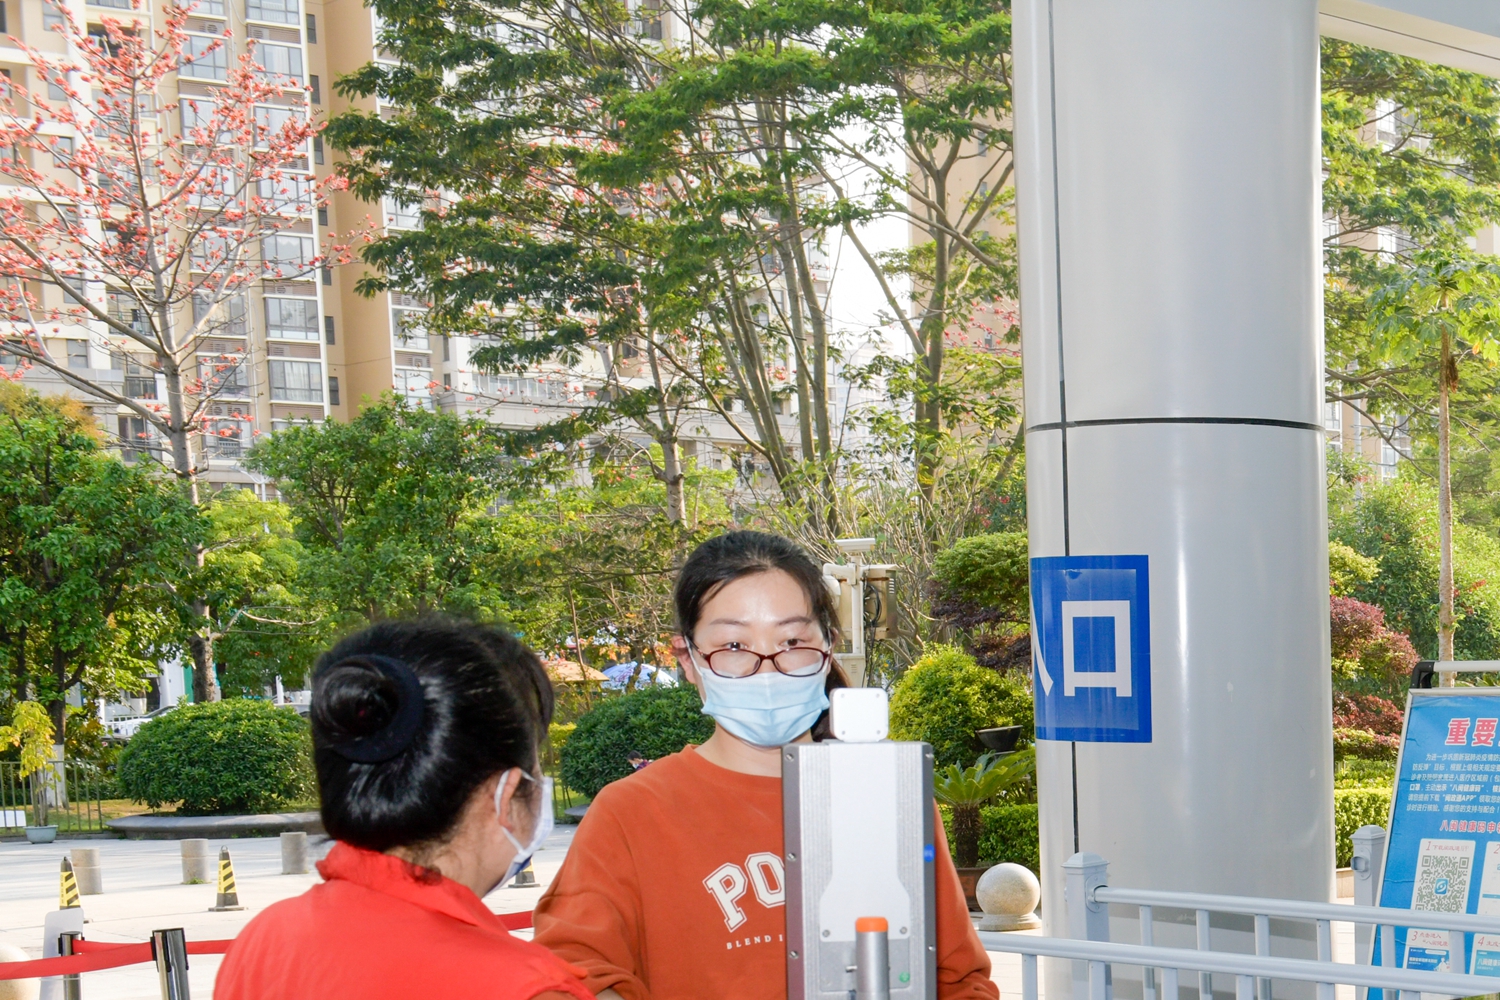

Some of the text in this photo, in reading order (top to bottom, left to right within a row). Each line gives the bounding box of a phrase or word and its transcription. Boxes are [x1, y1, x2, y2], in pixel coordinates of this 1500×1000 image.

[1425, 841, 1432, 851] 1
[1411, 930, 1418, 942] 3
[1478, 936, 1485, 946] 4
[726, 935, 772, 950] BLEND
